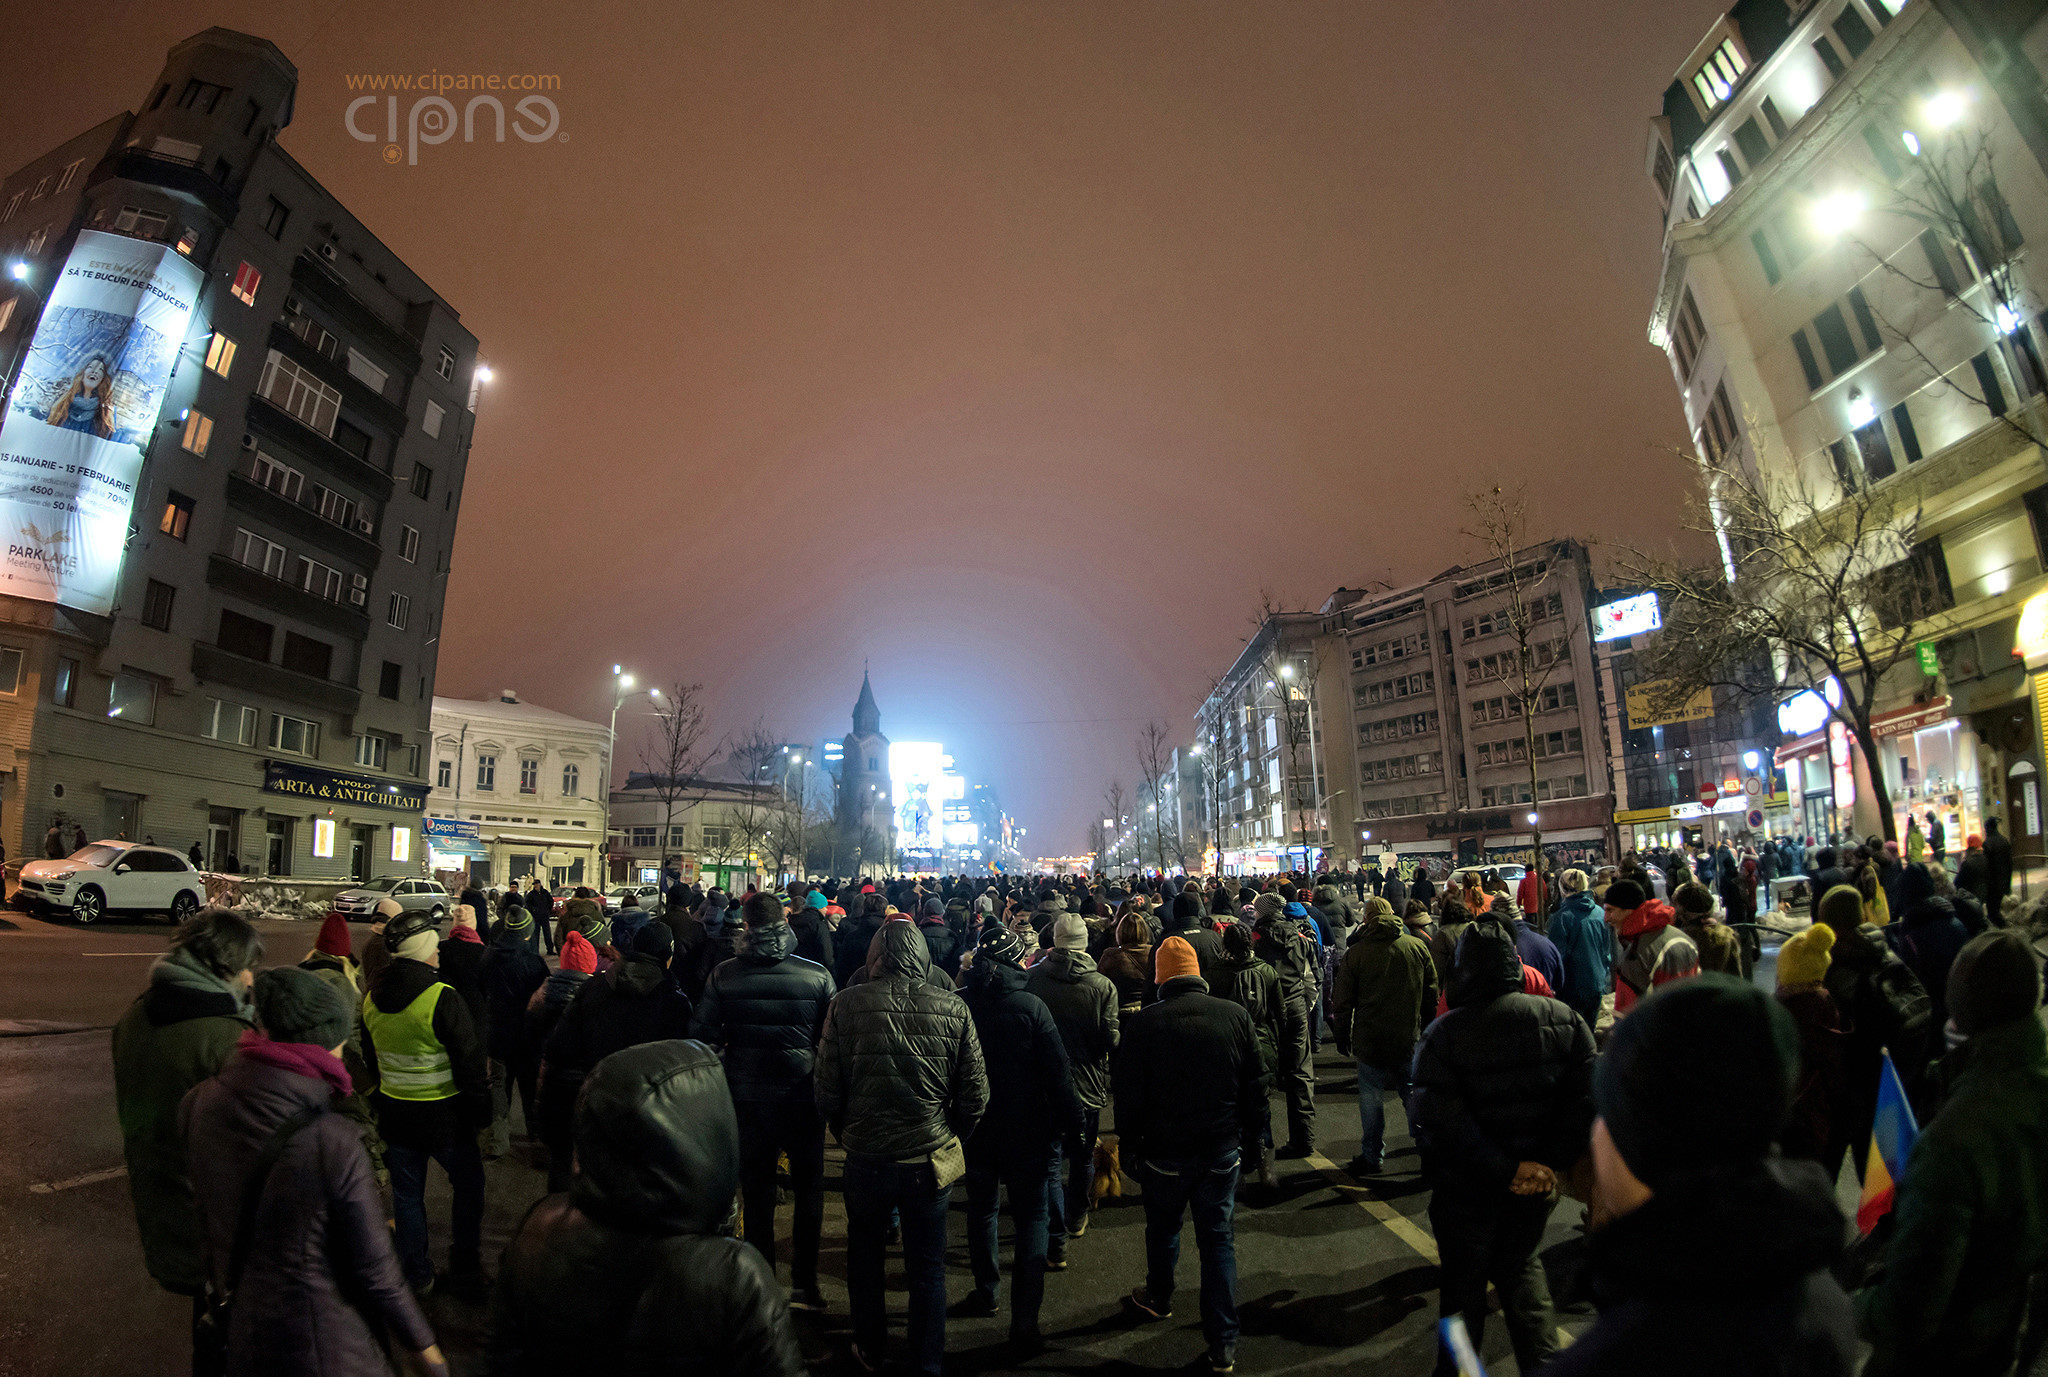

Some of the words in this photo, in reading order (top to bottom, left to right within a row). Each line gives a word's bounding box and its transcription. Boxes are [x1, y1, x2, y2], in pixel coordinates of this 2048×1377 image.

[89, 260, 112, 270] ESTE
[82, 269, 94, 279] TE
[94, 271, 131, 286] BUCURI
[130, 279, 146, 290] DE
[145, 282, 189, 312] REDUCERI
[0, 453, 9, 462] 15
[10, 455, 57, 471] IANUARIE
[66, 463, 76, 473] 15
[77, 466, 131, 493] FEBRUARIE
[30, 485, 54, 496] 4500
[52, 500, 65, 511] 50
[66, 502, 79, 513] lei
[7, 557, 41, 572] Meeting
[44, 563, 75, 577] Nature
[274, 778, 316, 796] ARTA
[319, 784, 331, 798] &
[333, 787, 421, 809] ANTICHITATI
[435, 823, 456, 833] pepsi
